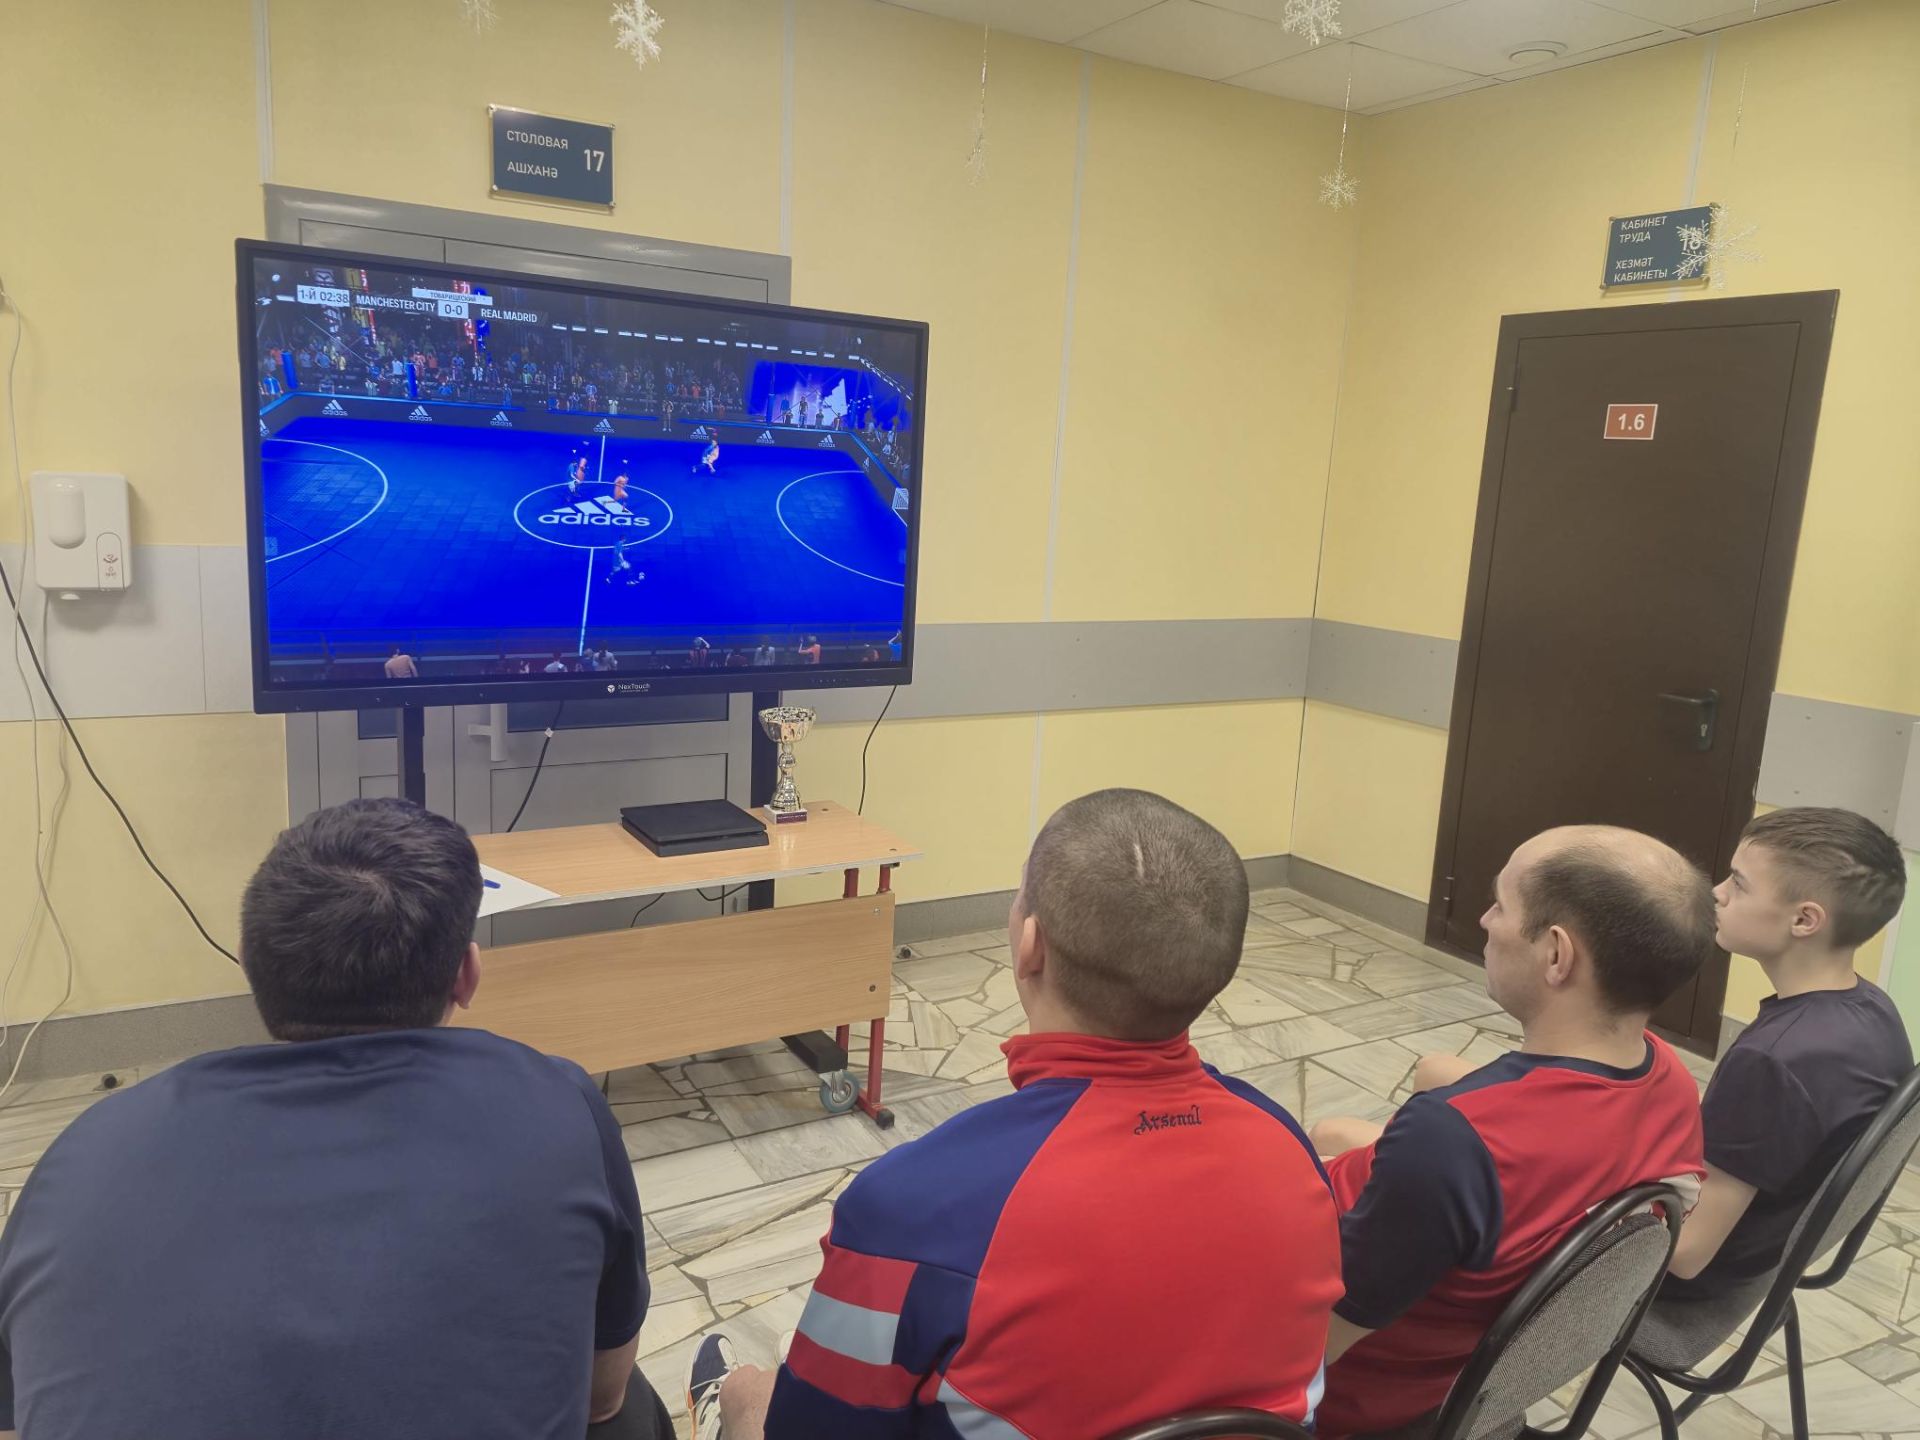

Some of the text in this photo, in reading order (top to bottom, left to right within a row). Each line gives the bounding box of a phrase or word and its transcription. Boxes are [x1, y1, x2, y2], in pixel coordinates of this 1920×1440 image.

[506, 130, 568, 149] СТОЛОВАЯ
[584, 149, 605, 172] 17
[1621, 216, 1667, 230] КАБИНЕТ
[1619, 231, 1651, 243] ТРУДА
[1615, 257, 1654, 269] ХЕЗМӘТ
[1614, 269, 1668, 282] КАБИНЕТЫ
[320, 291, 348, 303] 02:38
[356, 295, 435, 312] MANCHESTER CITY
[445, 304, 463, 315] 0-0
[481, 308, 538, 322] REAL MADRID
[1618, 413, 1645, 430] 1.6
[538, 513, 650, 527] adidas
[1134, 1104, 1202, 1135] Arsenal
